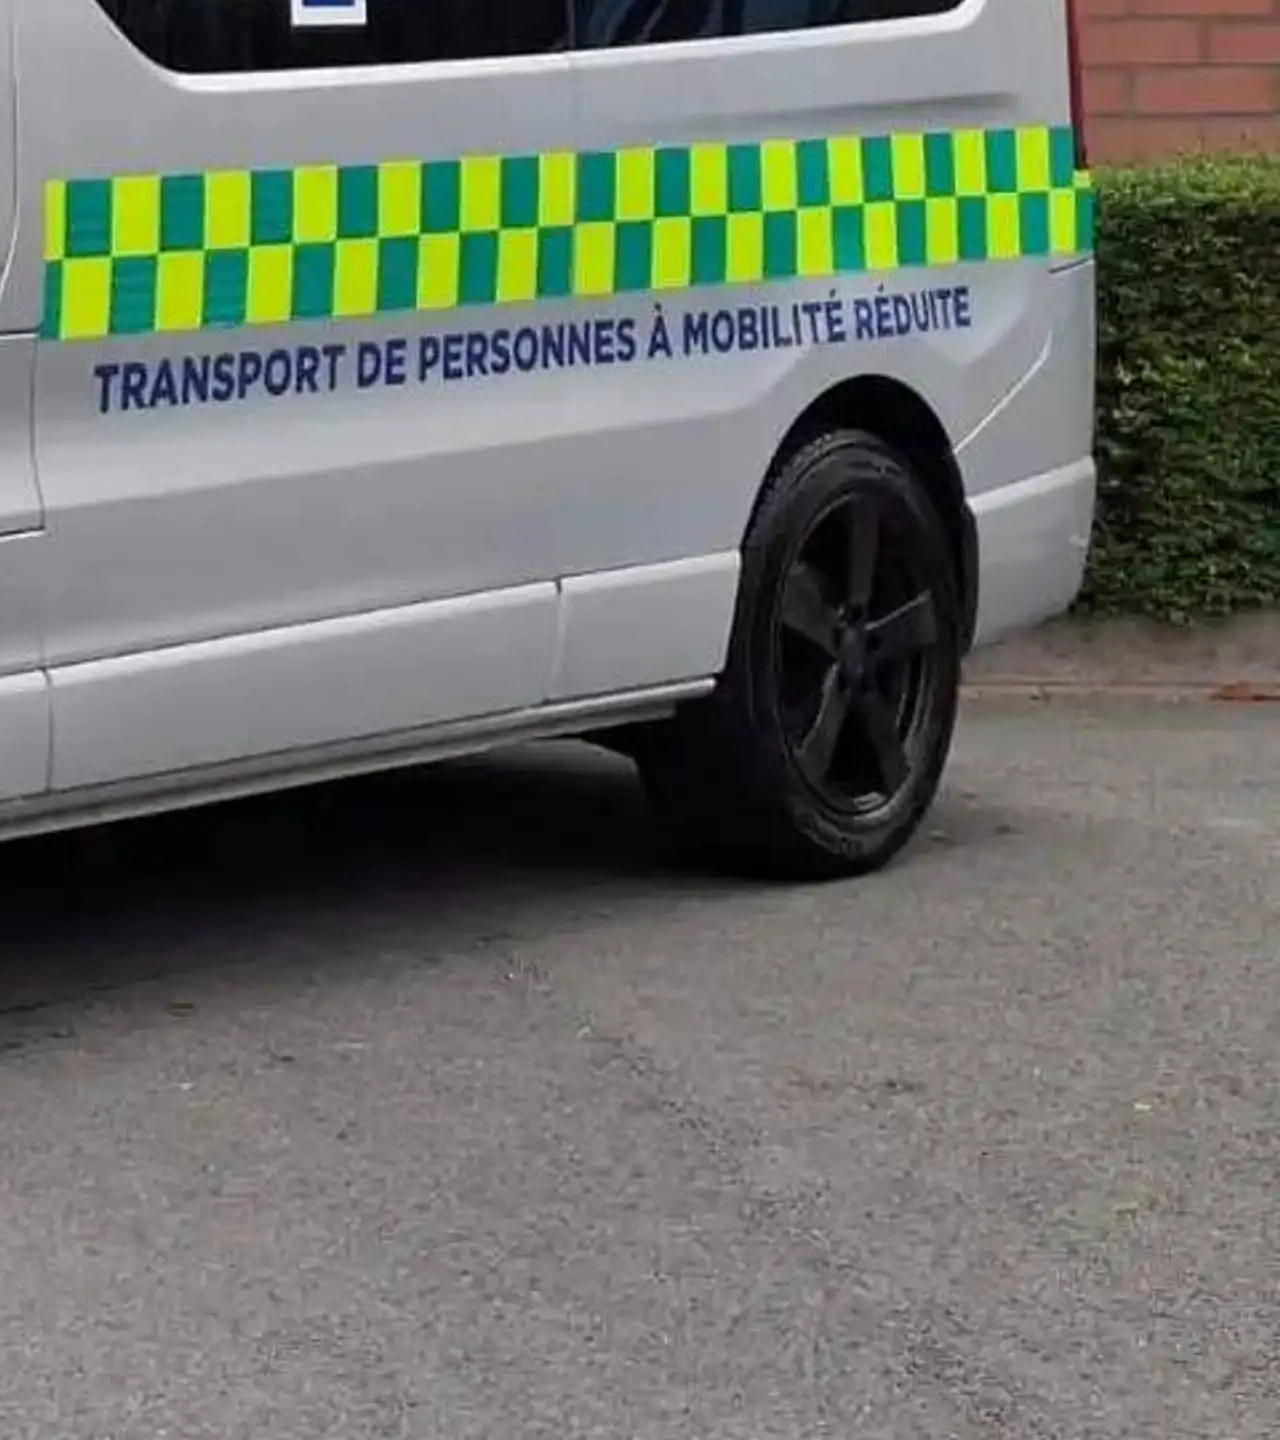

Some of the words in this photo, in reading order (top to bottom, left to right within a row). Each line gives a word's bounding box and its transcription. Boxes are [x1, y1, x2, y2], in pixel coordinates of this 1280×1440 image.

[93, 344, 345, 413] TRANSPORT
[356, 338, 407, 388] DE
[419, 318, 636, 382] PERSONNES
[648, 302, 672, 359] À
[682, 290, 845, 357] MOBILITÉ
[856, 284, 972, 339] RÉDUITE
